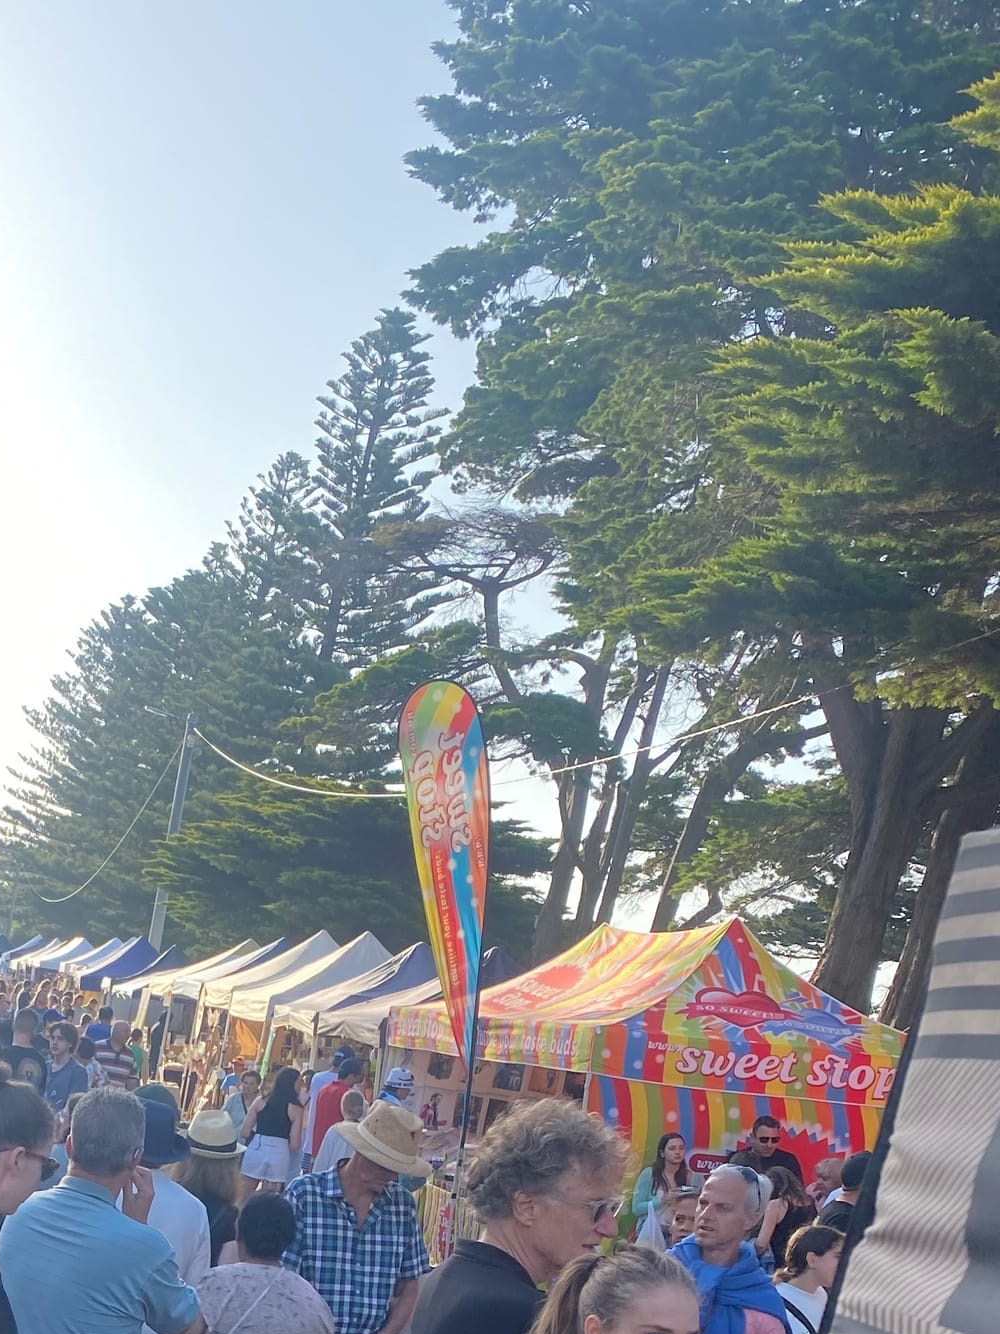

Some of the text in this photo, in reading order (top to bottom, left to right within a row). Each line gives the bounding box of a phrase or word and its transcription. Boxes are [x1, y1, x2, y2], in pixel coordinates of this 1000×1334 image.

[520, 1030, 548, 1053] taste
[549, 1026, 585, 1057] buds!
[675, 1047, 897, 1100] sweet stop
